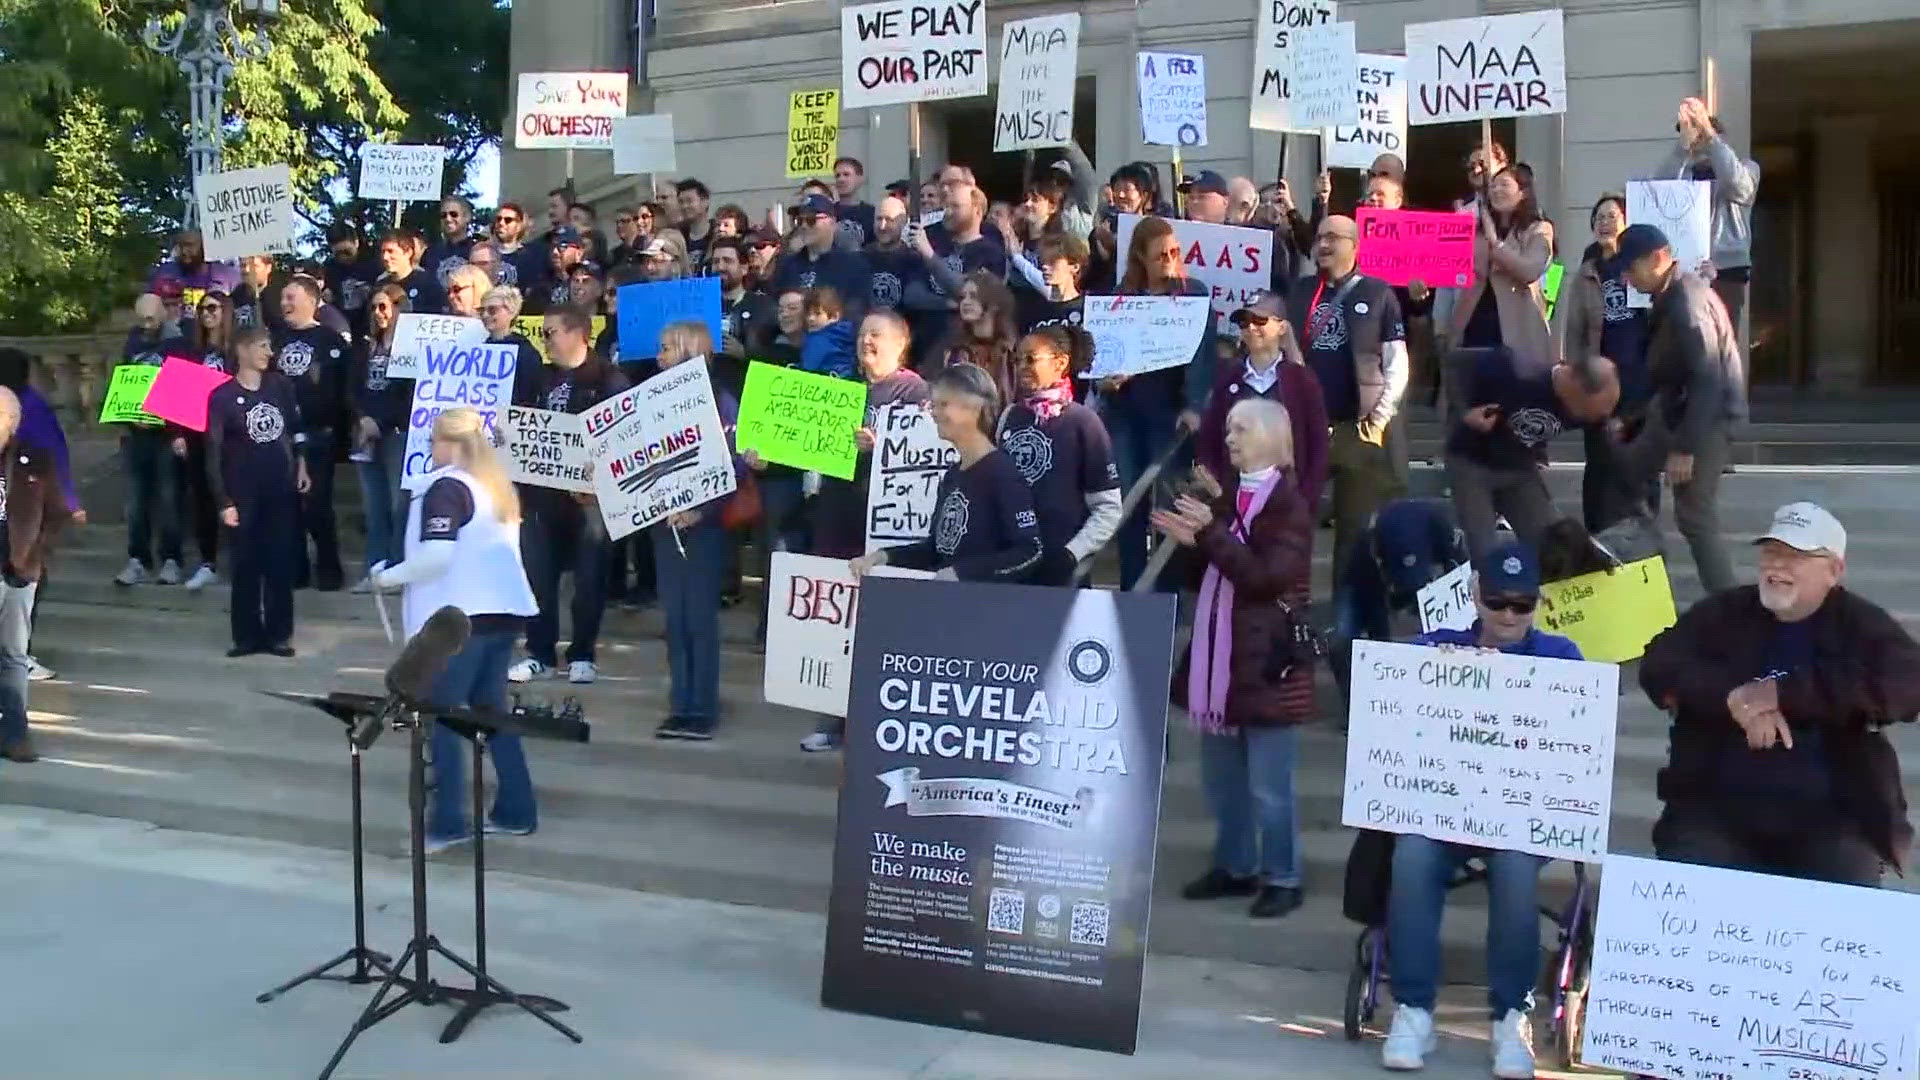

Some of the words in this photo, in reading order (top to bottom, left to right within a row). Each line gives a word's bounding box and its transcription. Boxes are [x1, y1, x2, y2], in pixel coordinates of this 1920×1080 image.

[857, 10, 903, 41] WE
[911, 0, 981, 36] PLAY
[1272, 0, 1330, 28] DON'T
[1004, 25, 1067, 60] MAA
[858, 57, 919, 89] OUR
[923, 49, 982, 80] PART
[1438, 40, 1541, 81] MAA
[1356, 66, 1395, 87] EST
[794, 91, 835, 109] KEEP
[1357, 89, 1379, 105] IN
[1420, 80, 1551, 116] UNFAIR
[803, 111, 824, 125] THE
[996, 109, 1069, 147] MUSIC
[1359, 108, 1393, 124] HE
[794, 142, 829, 156] WORLD
[1335, 125, 1400, 150] LAND
[790, 153, 830, 171] CLASS!
[207, 189, 233, 213] OUR
[232, 183, 287, 210] FUTURE
[213, 219, 227, 240] AT
[231, 207, 277, 235] STAKE
[1184, 240, 1260, 273] AA'S
[416, 318, 465, 337] KEEP
[119, 368, 149, 385] THIS
[426, 344, 515, 380] WORLD
[416, 379, 499, 405] CLASS
[671, 393, 707, 415] THEIR
[769, 376, 861, 409] CLEVELAND'S
[508, 409, 552, 429] PLAY
[586, 390, 640, 435] LEGACY
[773, 423, 800, 443] THE
[510, 443, 562, 461] STAND
[788, 575, 860, 629] BEST
[1423, 598, 1449, 630] For
[881, 653, 975, 679] PROTECT
[981, 661, 1039, 684] YOUR
[1373, 662, 1407, 681] STOP
[1505, 678, 1533, 690] OUR
[879, 677, 1120, 730] CLEVELAND
[1369, 699, 1403, 717] THIS
[1416, 703, 1465, 721] COULD
[1474, 710, 1501, 726] HAVE
[875, 718, 1128, 775] ORCHESTRA
[1368, 747, 1407, 768] MAA
[1418, 754, 1446, 772] HAS
[1457, 759, 1485, 776] THE
[1556, 771, 1575, 784] TO
[1383, 771, 1461, 797] COMPOSE
[1502, 787, 1533, 803] FAIR
[1542, 794, 1601, 812] CONTRACT
[1366, 799, 1424, 828] BRING
[1434, 812, 1457, 831] THE
[873, 832, 905, 854] We
[910, 841, 966, 862] make
[871, 856, 903, 877] the
[909, 864, 974, 887] music.
[1657, 910, 1697, 936] YOU
[1713, 919, 1754, 943] ARE
[1766, 928, 1808, 949] NOT
[1605, 937, 1660, 958] TAKERS
[1671, 946, 1691, 959] OF
[1708, 949, 1793, 975] DONATIONS
[1822, 963, 1850, 983] YOU
[1869, 976, 1906, 994] ARE
[1600, 969, 1695, 994] CARETAKERS
[1709, 983, 1732, 998] OF
[1749, 989, 1781, 1007] THE
[1793, 989, 1866, 1019] ART
[1596, 998, 1673, 1021] THROUGH
[1687, 1010, 1722, 1028] THE
[1591, 1030, 1639, 1049] WATER
[1649, 1040, 1678, 1058] THE
[1687, 1047, 1736, 1066] PLANT
[1601, 1054, 1655, 1071] WITHHOLD
[1663, 1064, 1686, 1078] THE
